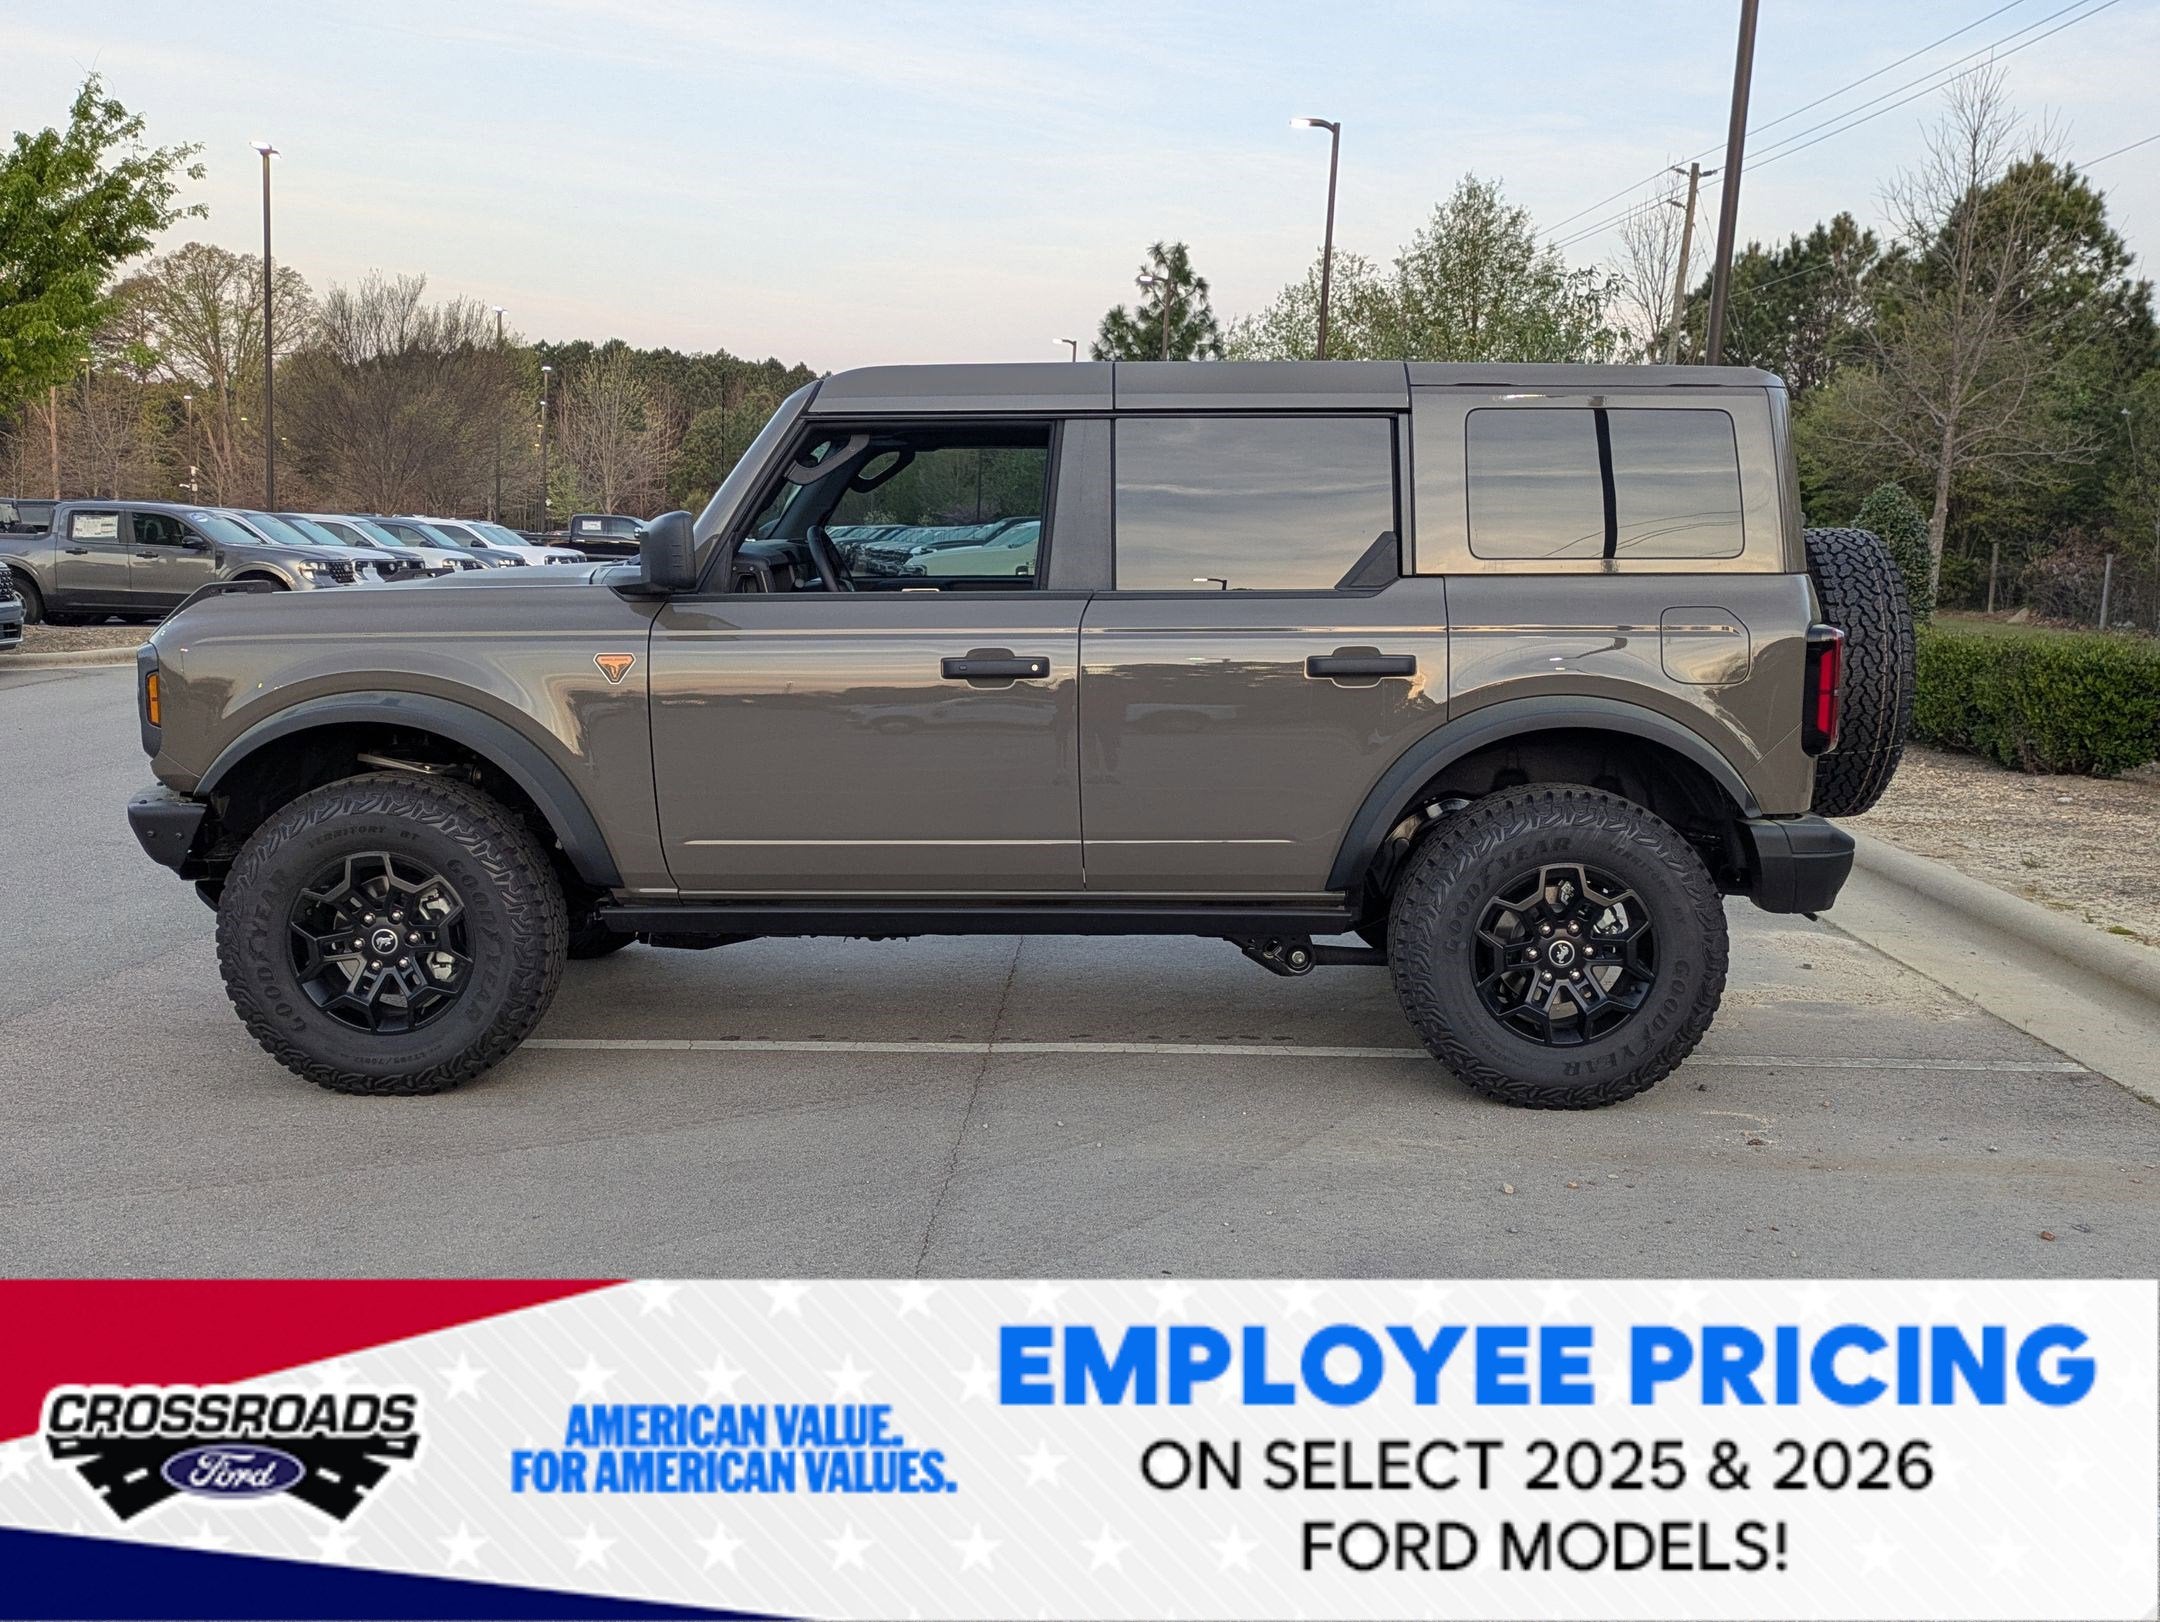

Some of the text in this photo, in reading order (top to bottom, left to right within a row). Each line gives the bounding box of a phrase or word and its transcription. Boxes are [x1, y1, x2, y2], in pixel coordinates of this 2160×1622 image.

[248, 868, 306, 1032] GOODYEAR
[447, 858, 503, 1024] GOODYEAR
[1446, 837, 1571, 955] GOODYEAR
[1563, 960, 1690, 1076] GOODYEAR
